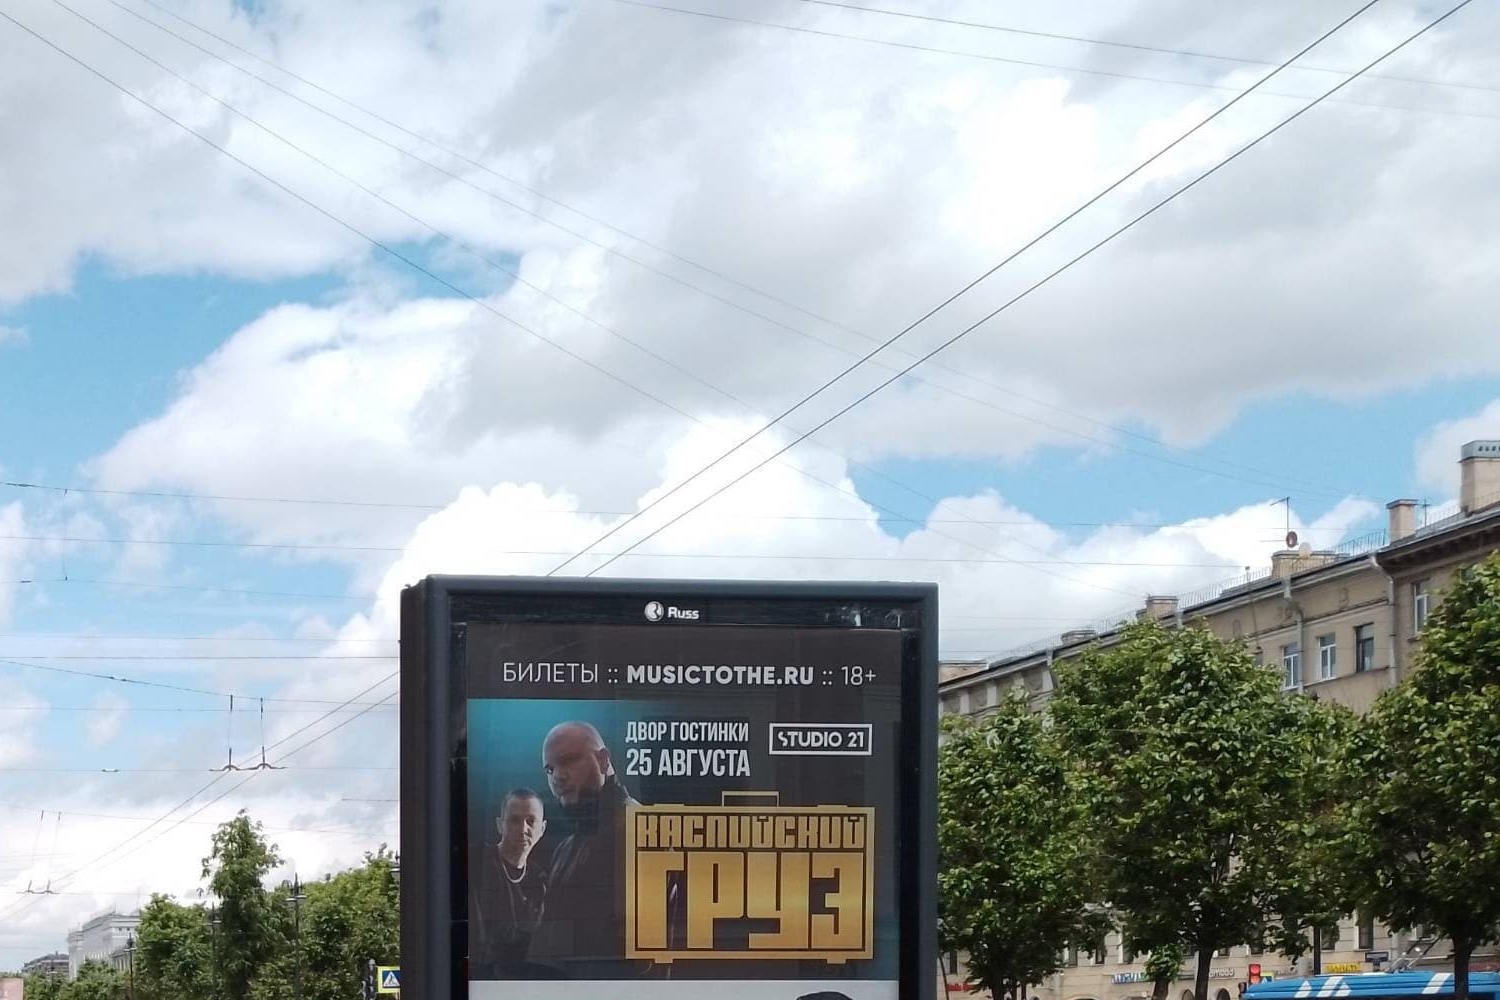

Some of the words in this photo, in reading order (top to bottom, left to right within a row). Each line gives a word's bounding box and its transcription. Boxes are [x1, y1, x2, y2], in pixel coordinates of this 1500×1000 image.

[667, 606, 700, 620] Russ
[502, 661, 599, 684] БИЛЕТЫ
[626, 664, 814, 686] MUSICTOTHE.RU
[840, 665, 877, 686] 18+
[625, 721, 668, 744] ДВОР
[670, 721, 750, 743] ГОСТИНКИ
[777, 730, 843, 748] STUDIO
[846, 730, 865, 748] 21
[625, 748, 653, 777] 25
[658, 748, 751, 777] АВГУСТА
[636, 815, 865, 849] КАСПИЙСКИЙ
[636, 851, 865, 950] ГРУЗ
